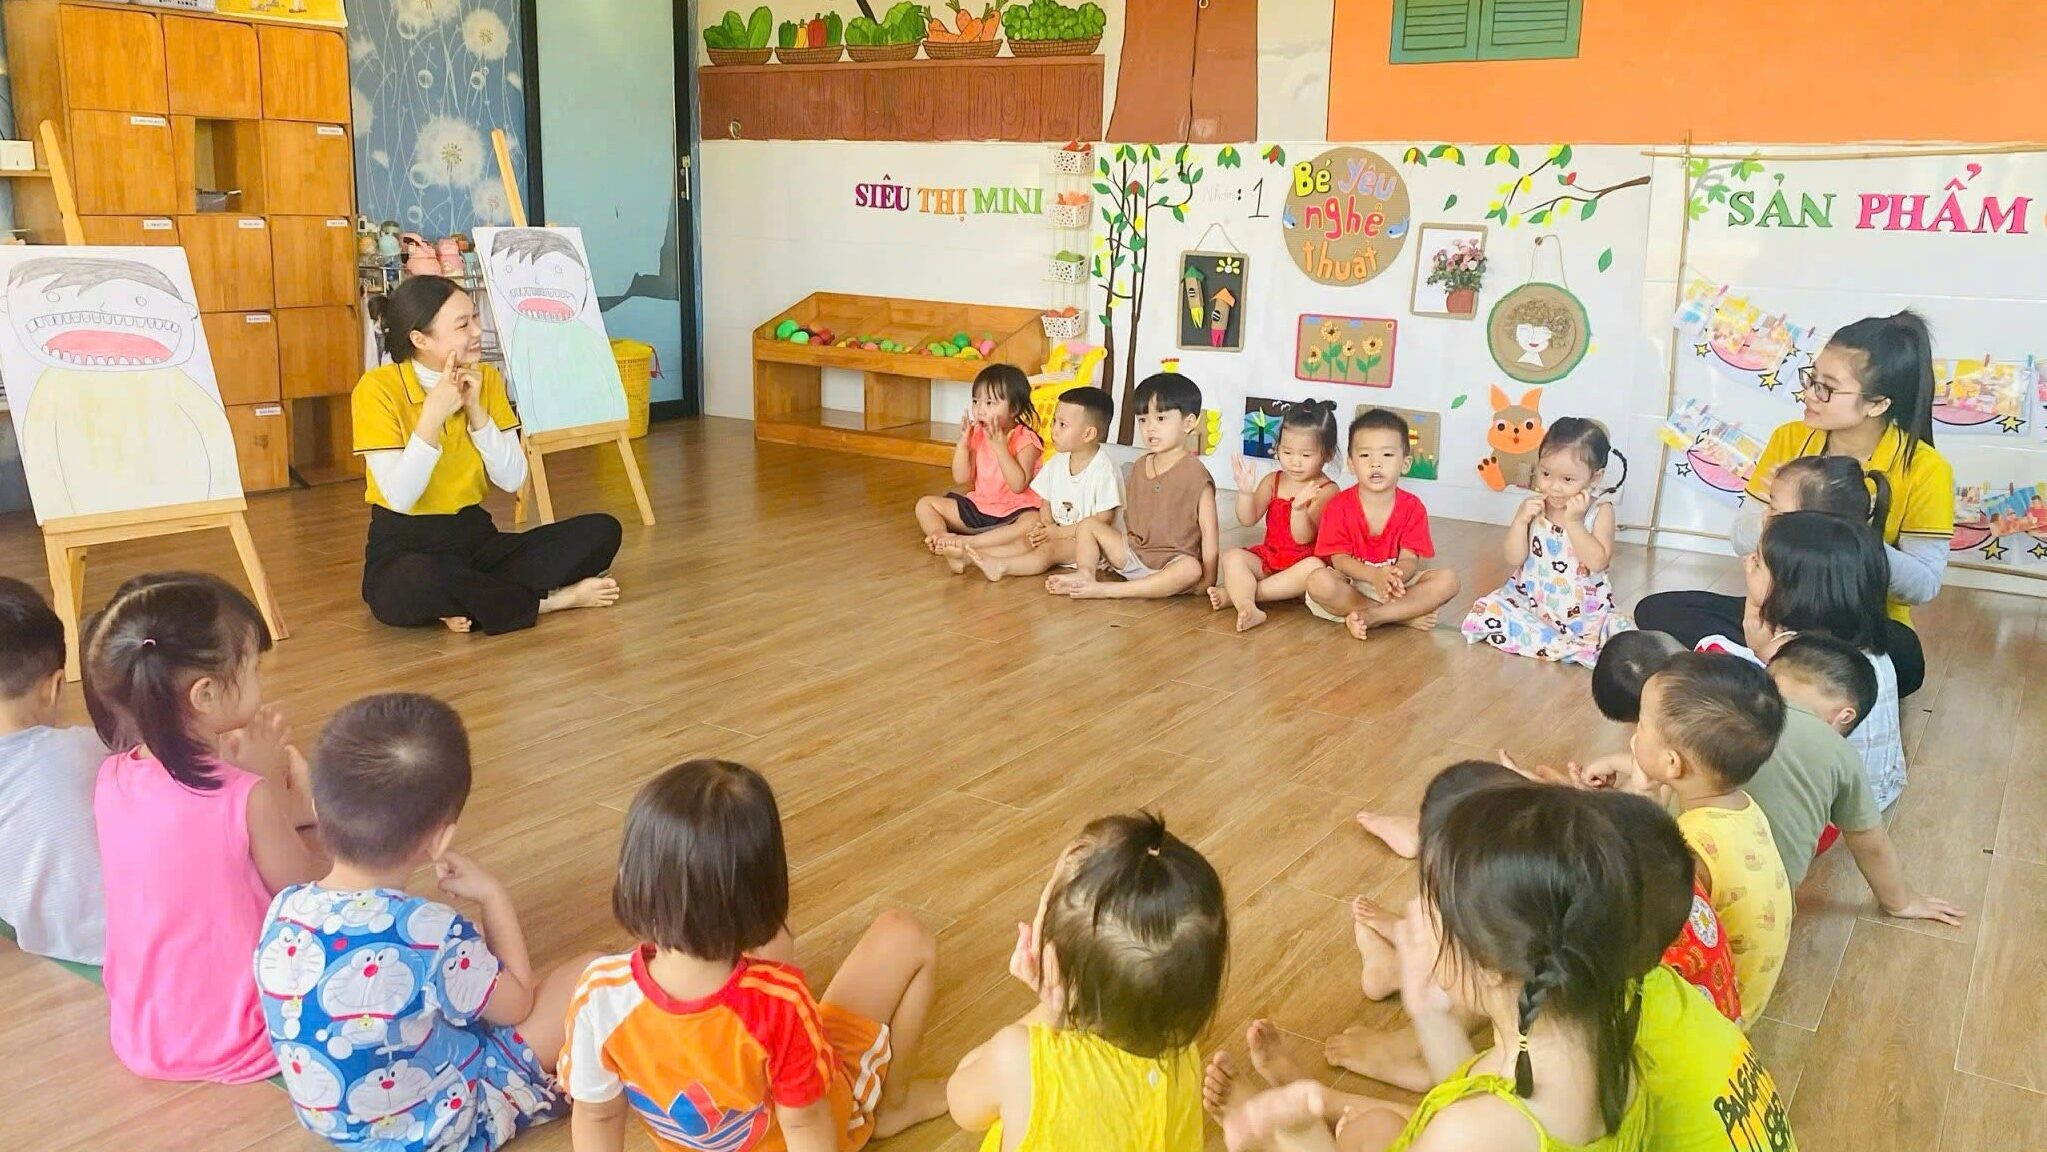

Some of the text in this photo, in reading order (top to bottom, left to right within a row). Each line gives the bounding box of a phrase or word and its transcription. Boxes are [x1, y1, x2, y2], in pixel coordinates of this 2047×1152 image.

[855, 173, 1044, 222] SIÊU THỊ MINI
[1293, 160, 1332, 197] Bé
[1728, 163, 2034, 234] SẢN PHẨM
